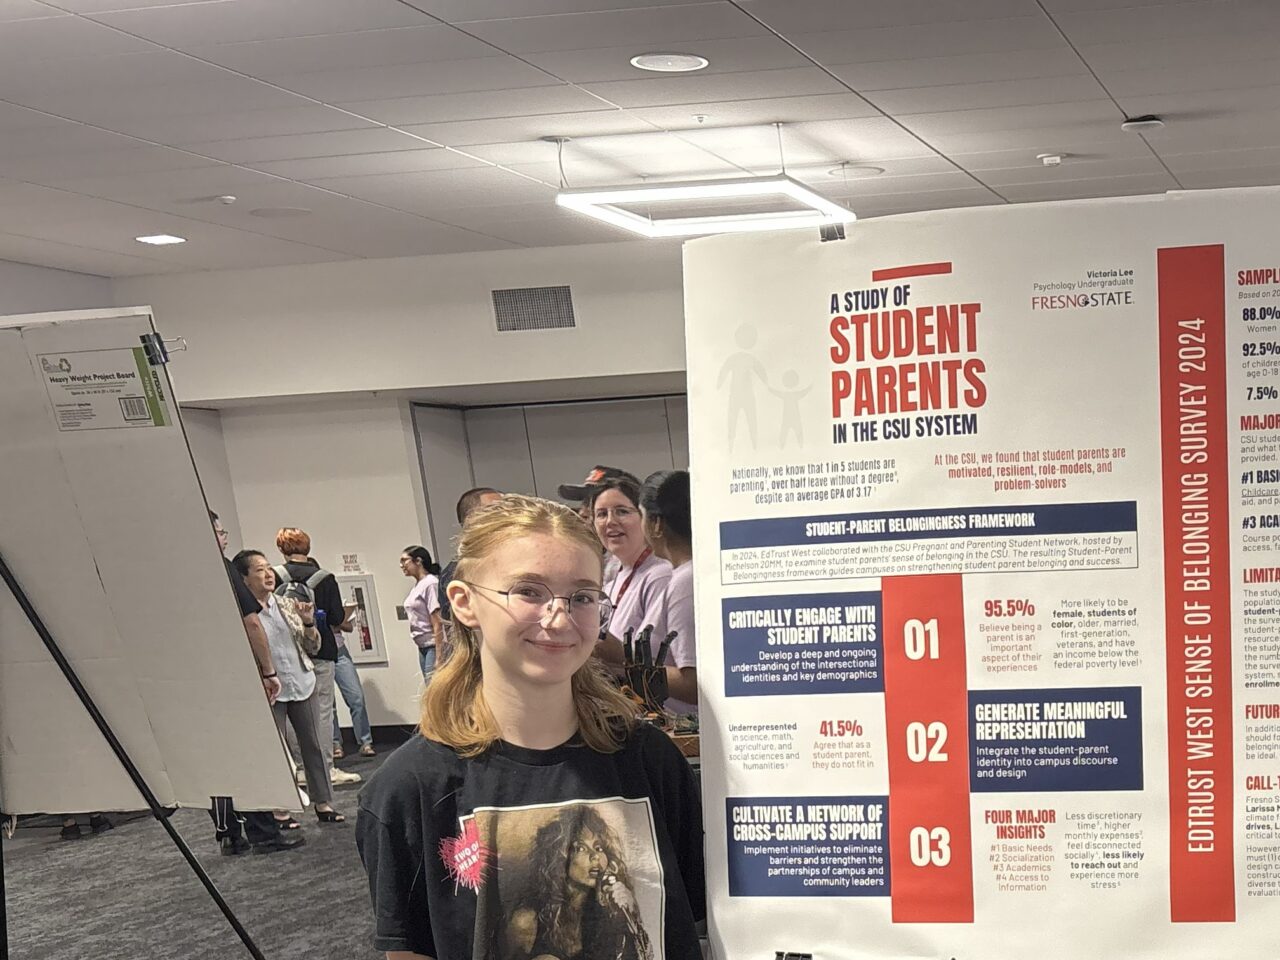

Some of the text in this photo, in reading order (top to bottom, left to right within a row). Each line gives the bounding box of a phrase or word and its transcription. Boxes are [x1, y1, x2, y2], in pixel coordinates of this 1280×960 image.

[1087, 269, 1117, 278] Victoria
[1033, 278, 1134, 292] Psychology Undergraduate
[831, 285, 910, 313] A STUDY OF
[1242, 306, 1280, 321] 88.0%
[830, 303, 981, 364] STUDENT
[1247, 325, 1277, 333] Women
[1242, 342, 1280, 357] 92.5%
[832, 358, 987, 418] PARENTS
[1247, 386, 1278, 401] 7.5%
[833, 413, 977, 444] IN THE CSU SYSTEM
[935, 448, 1126, 465] At the CSU, we found that student parents are
[948, 461, 1112, 479] motivated, resilient, role-models, and
[1242, 471, 1253, 484] #1
[994, 477, 1066, 492] problem-solvers
[805, 513, 1035, 537] STUDENT-PARENT BELONGINGNESS FRAMEWORK
[1242, 516, 1256, 529] #3
[1178, 318, 1215, 853] EDTRUST WEST SENSE OF BELONGING SURVEY 2024
[984, 599, 1035, 618] 95.5%
[729, 606, 875, 629] CRITICALLY ENGAGE WITH
[767, 624, 876, 645] STUDENT PARENTS
[903, 618, 940, 660] 01
[975, 701, 1127, 722] GENERATE MEANINGFUL
[729, 723, 797, 732] Underrepresented
[820, 720, 863, 737] 41.5%
[976, 721, 1085, 740] REPRESENTATION
[905, 721, 949, 763] 02
[977, 745, 1109, 758] Integrate the student-parent
[977, 756, 1118, 768] identity into campus discourse
[977, 768, 1027, 779] and design
[732, 804, 882, 824] CULTIVATE A NETWORK OF
[985, 810, 1056, 824] FOUR MAJOR
[1246, 805, 1275, 813] Larissa
[733, 823, 882, 842] CROSS-CAMPUS SUPPORT
[997, 825, 1045, 839] INSIGHTS
[454, 848, 471, 862] TWO
[909, 826, 951, 867] 03
[459, 851, 479, 872] HEART
[998, 883, 1046, 891] Information
